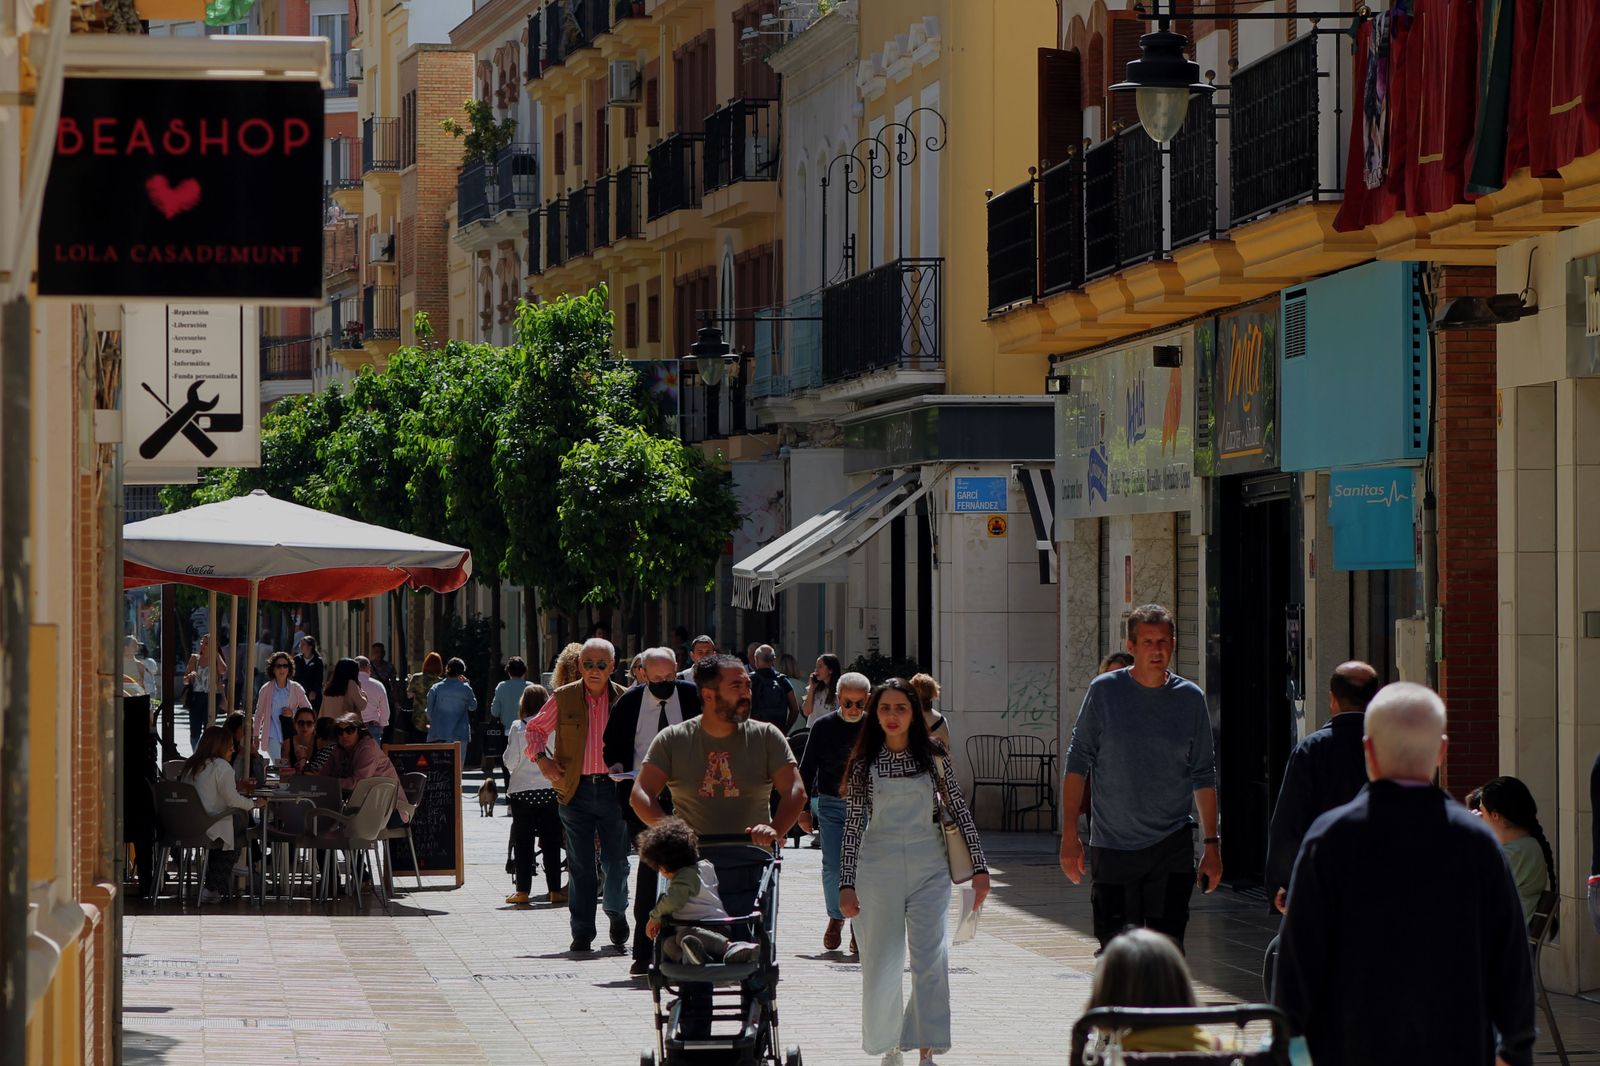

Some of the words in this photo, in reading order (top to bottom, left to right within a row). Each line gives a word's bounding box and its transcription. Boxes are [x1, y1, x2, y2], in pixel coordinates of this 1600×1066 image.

[56, 116, 311, 157] BEASHOP
[54, 243, 120, 264] LOLA
[130, 243, 303, 267] CASADEMUNT
[1334, 484, 1385, 497] Sanitas
[957, 500, 999, 510] FERNÁNDEZ
[697, 751, 740, 799] A
